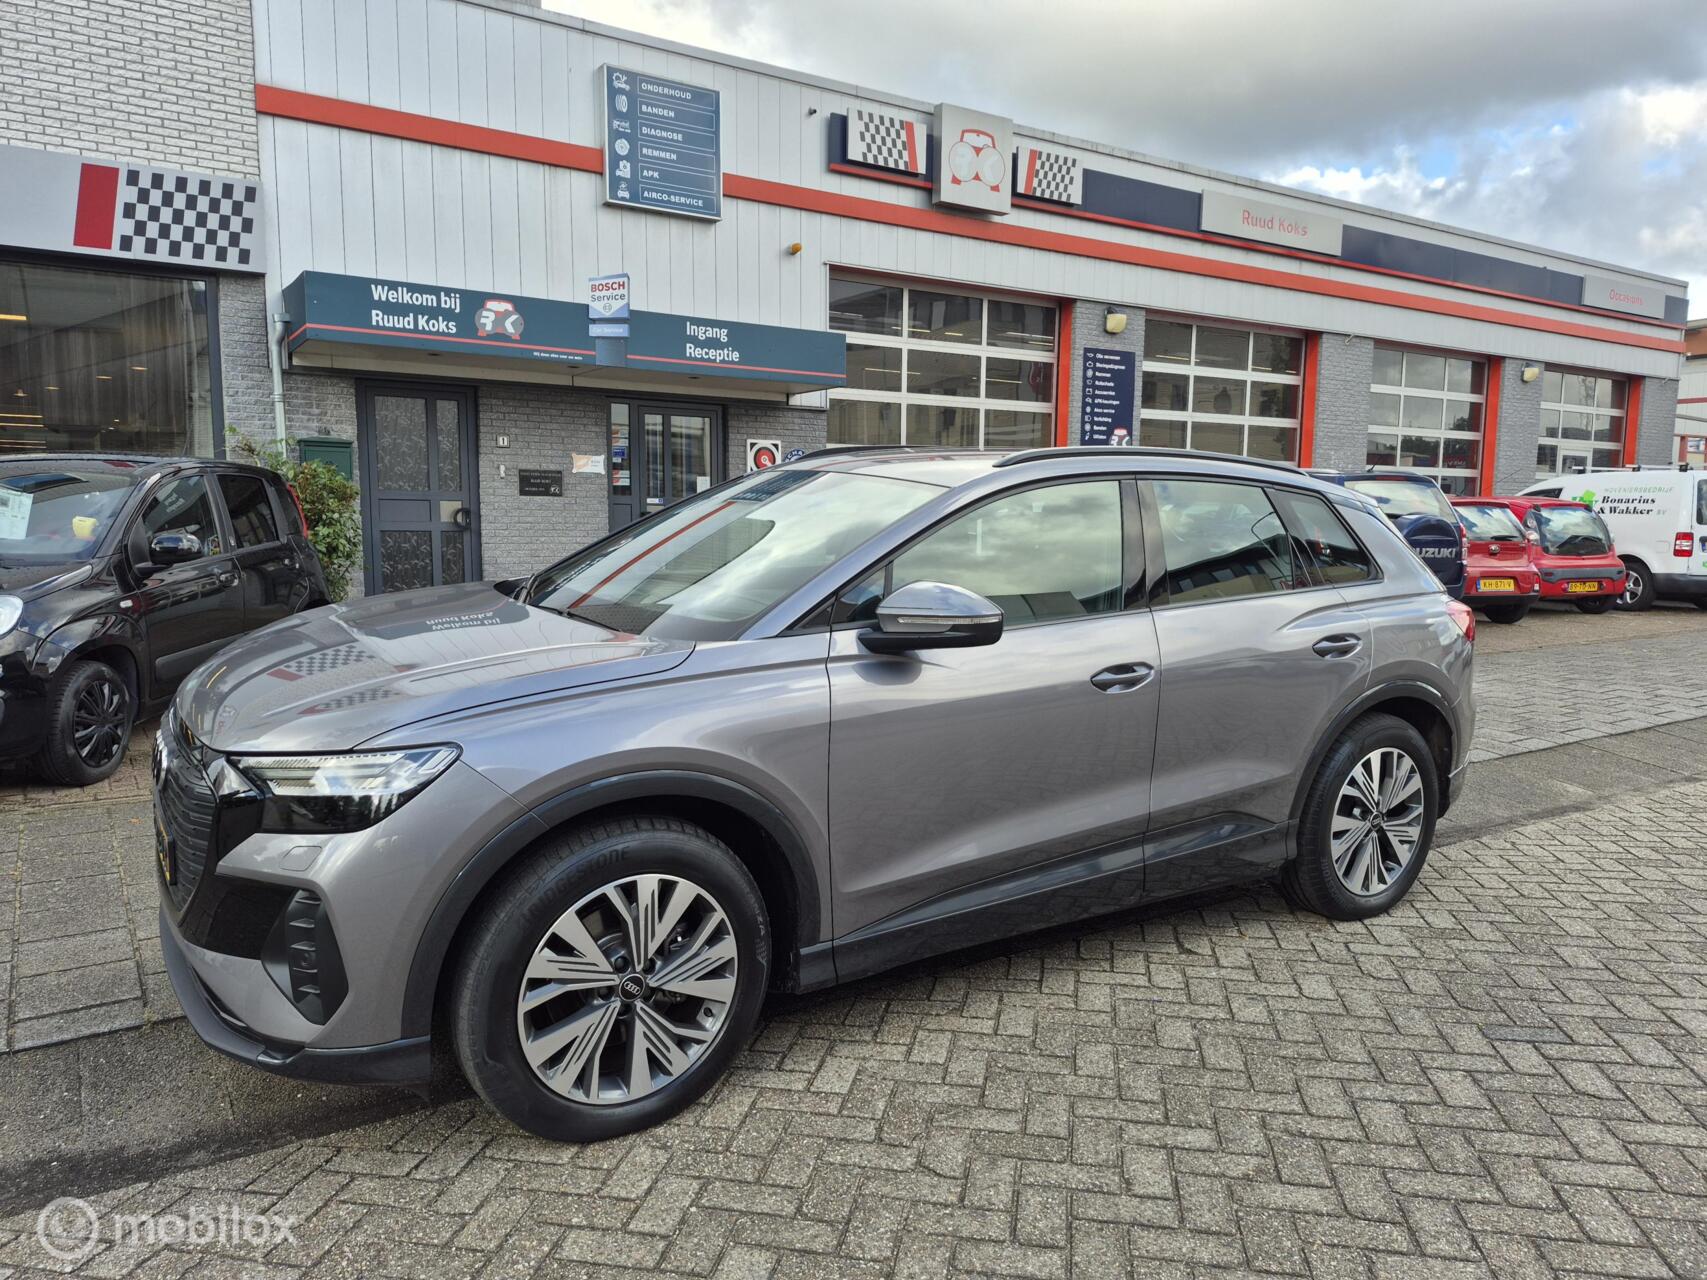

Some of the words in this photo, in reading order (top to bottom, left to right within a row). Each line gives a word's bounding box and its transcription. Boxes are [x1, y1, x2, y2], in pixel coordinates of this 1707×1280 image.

[641, 82, 692, 100] ONDERHOUD
[641, 104, 675, 118] BANDEN
[641, 126, 683, 141] DIAGNOSE
[642, 147, 677, 161] REMMEN
[642, 169, 660, 179] APK
[643, 190, 704, 207] AIRCO-SERVICE
[1242, 209, 1274, 230] Ruud
[1278, 217, 1308, 237] Koks
[590, 281, 626, 293] BOSCH
[371, 284, 438, 307] Welkom
[440, 292, 461, 313] bij
[590, 293, 626, 302] Service
[371, 310, 415, 330] Ruud
[418, 315, 457, 335] Koks
[686, 321, 728, 342] Ingang
[685, 343, 740, 364] Receptie
[1601, 495, 1657, 505] Bonarius
[1608, 506, 1654, 516] Wakker
[1412, 547, 1457, 559] UZUKI
